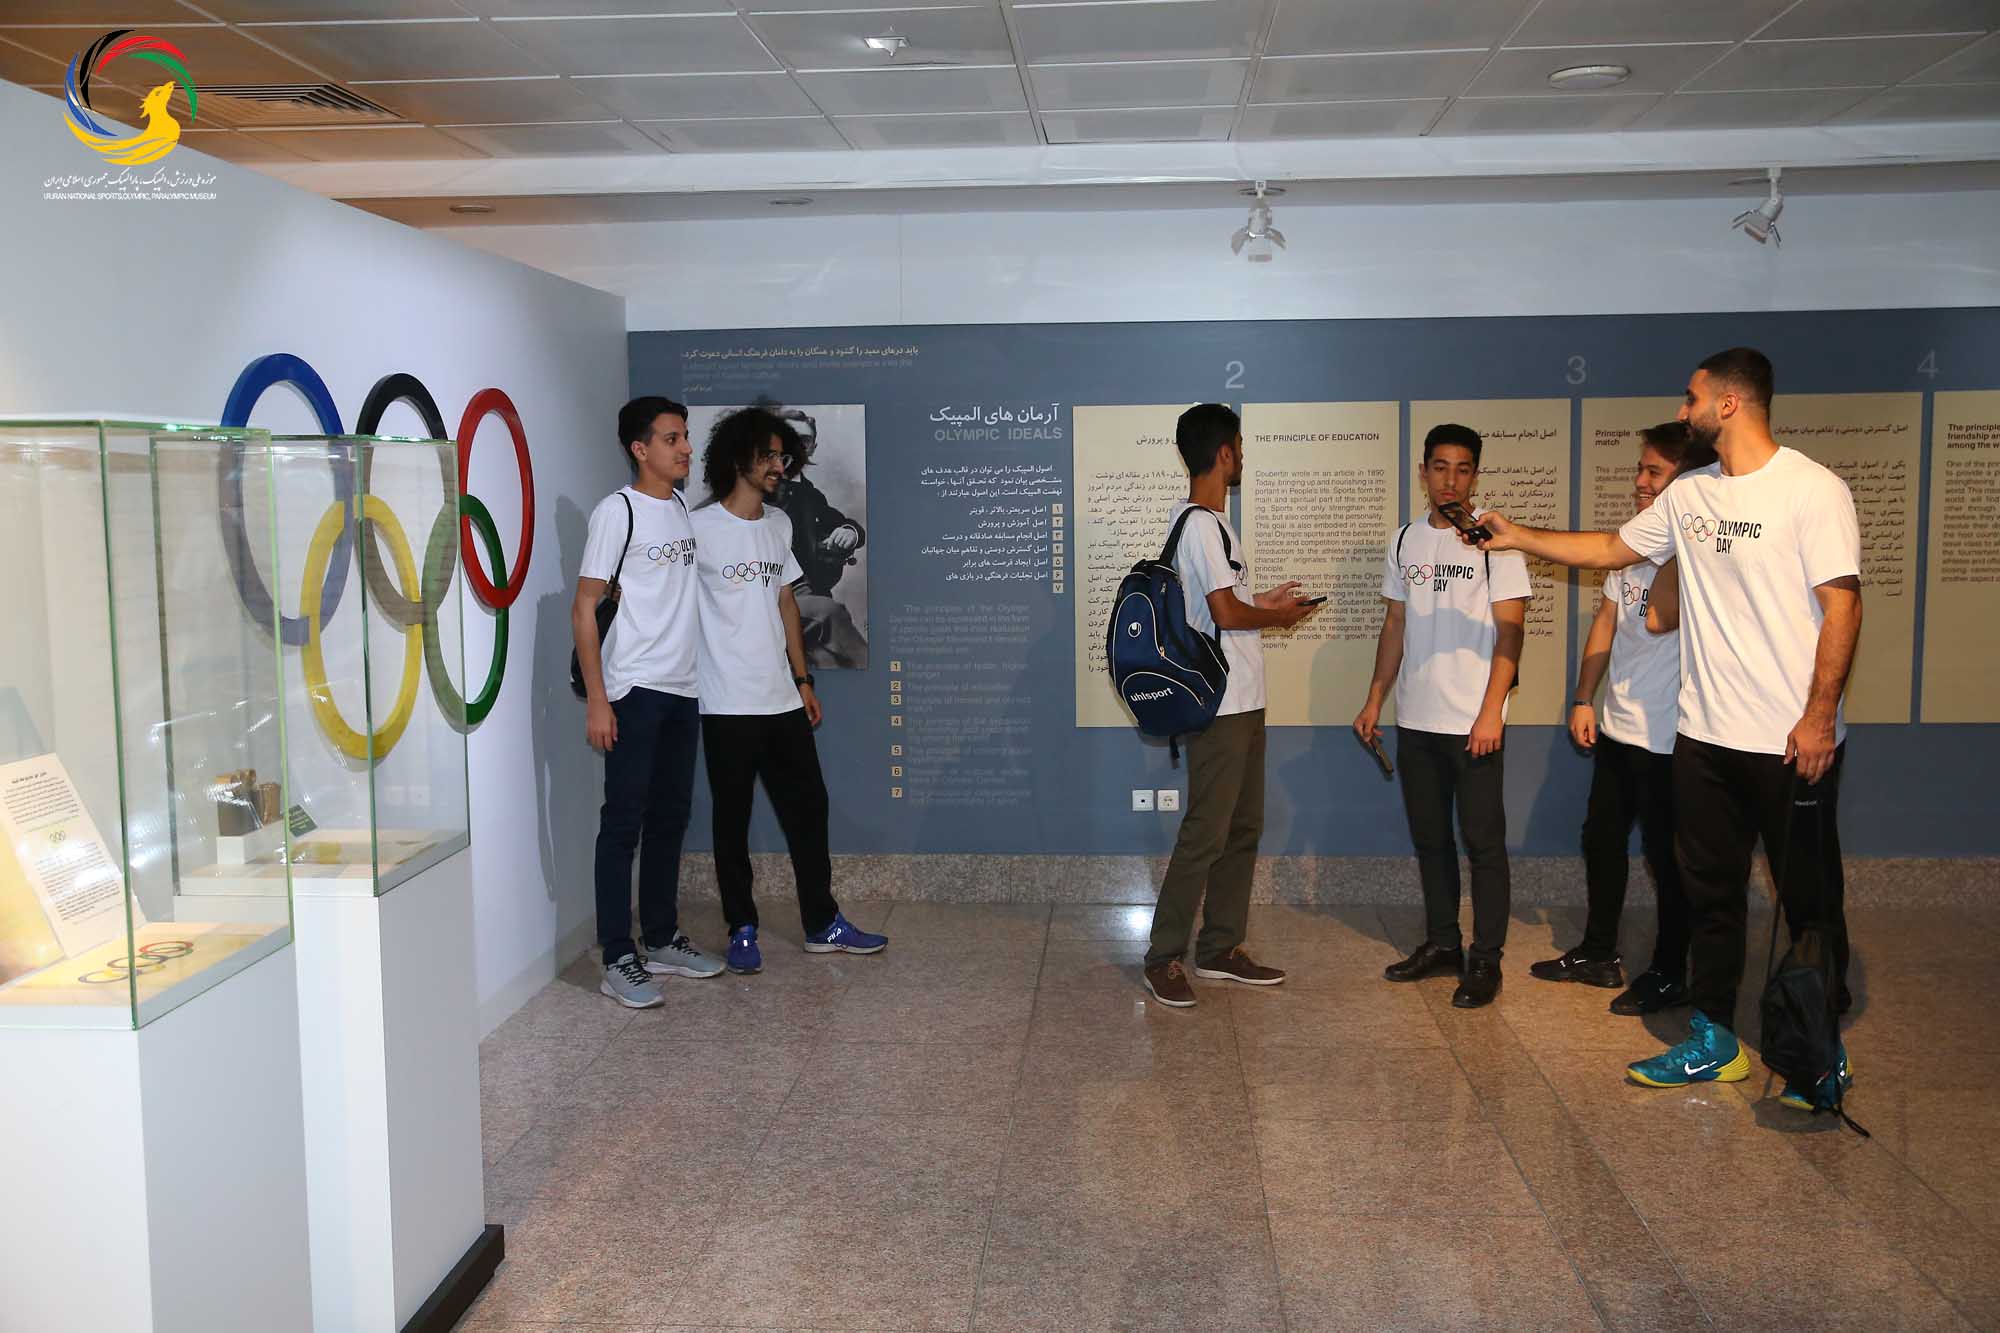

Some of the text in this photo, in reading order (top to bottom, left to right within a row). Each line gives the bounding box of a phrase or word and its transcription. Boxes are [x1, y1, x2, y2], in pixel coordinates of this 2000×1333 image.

[1917, 349, 1939, 379] 4
[1225, 360, 1245, 389] 2
[1566, 355, 1586, 384] 3
[929, 402, 1060, 427] آرمان های المپیک
[1948, 423, 1964, 431] The
[934, 427, 1063, 441] OLYMPIC IDEALS
[1255, 432, 1380, 442] THE PRINCIPLE OF EDUCATION
[1491, 430, 1517, 440] مسابقه
[1518, 429, 1538, 441] انجام
[1540, 428, 1557, 440] اصل
[1595, 429, 1631, 438] Principle
[1947, 432, 1990, 441] friendship
[1136, 435, 1163, 445] پرورش
[1947, 442, 1976, 451] among
[920, 466, 934, 475] های
[935, 465, 952, 474] هدف
[953, 465, 968, 475] قالب
[979, 465, 993, 475] توان
[994, 467, 1004, 475] می
[1004, 465, 1011, 474] را
[1012, 465, 1034, 475] المپیک
[1036, 464, 1053, 474] اصول
[920, 478, 946, 486] خواسته
[966, 477, 987, 486] تحقق
[1000, 477, 1014, 486] نمود
[1015, 476, 1028, 486] بیان
[1028, 476, 1062, 486] مشخصی
[971, 488, 988, 497] اصول
[989, 488, 1000, 497] این
[1019, 488, 1041, 497] المپیک
[1042, 488, 1063, 496] نهضت
[969, 505, 985, 516] قویتر
[1032, 505, 1047, 515] اصل
[977, 519, 1000, 528] پرورش
[1007, 517, 1030, 528] آموزش
[1032, 519, 1047, 528] اصل
[1717, 520, 1762, 539] OLYMPIC
[969, 532, 993, 540] صادقانه
[994, 531, 1015, 541] مسابقه
[1016, 531, 1033, 542] انجام
[1033, 531, 1048, 540] اصل
[921, 546, 945, 555] جهانیان
[946, 546, 960, 554] میان
[984, 546, 1005, 554] دوستی
[1006, 544, 1032, 554] گسترش
[1033, 544, 1048, 554] اصل
[1716, 537, 1733, 554] DAY
[961, 546, 978, 556] تفاهم
[683, 552, 695, 566] DAY
[963, 557, 1048, 568] اصل ایجاد فرصت های برابر
[946, 572, 958, 581] های
[960, 572, 974, 581] بازی
[984, 571, 1008, 581] فرهنگی
[1034, 571, 1048, 580] اصل
[1434, 564, 1474, 580] OLYMPIC
[1433, 579, 1448, 592] DAY
[1130, 687, 1174, 702] uhlsport
